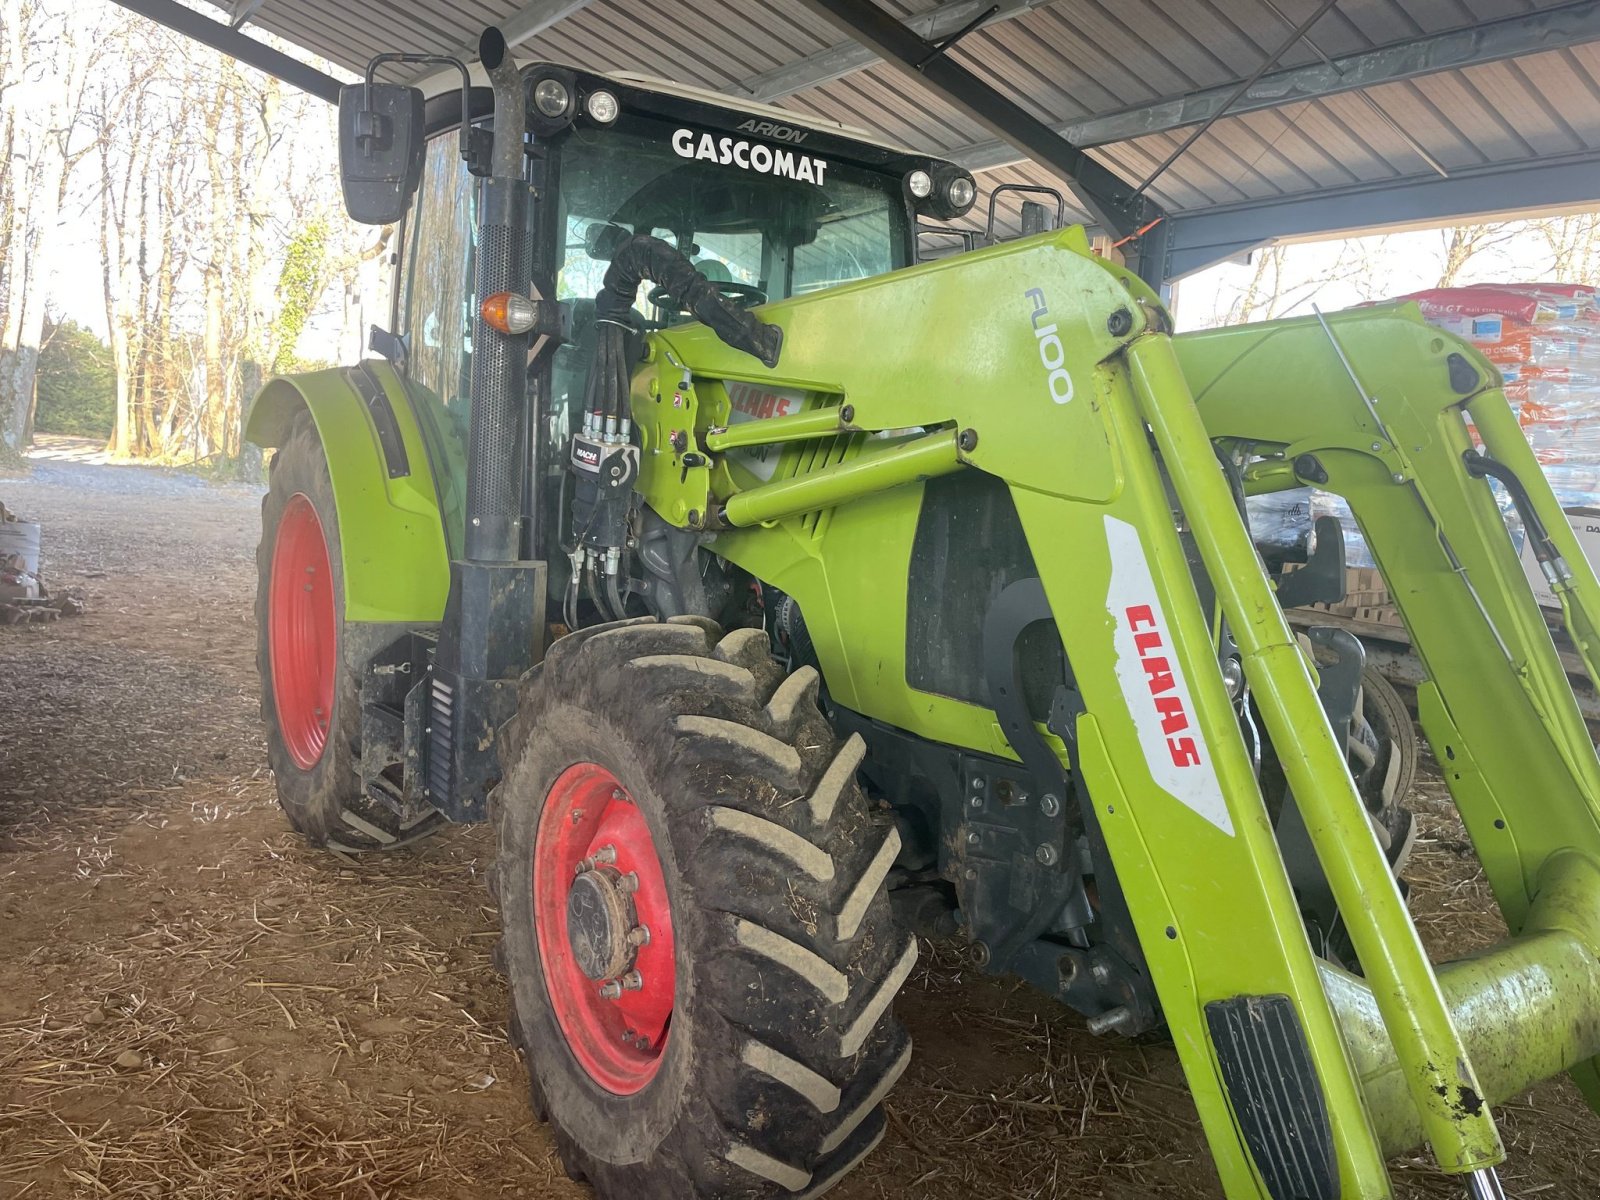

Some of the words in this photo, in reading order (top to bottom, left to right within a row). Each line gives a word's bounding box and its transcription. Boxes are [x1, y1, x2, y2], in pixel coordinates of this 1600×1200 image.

[736, 119, 808, 143] ARION
[672, 128, 827, 186] GASCOMAT
[730, 383, 791, 419] CLAAS
[1126, 604, 1201, 768] CLAAS
